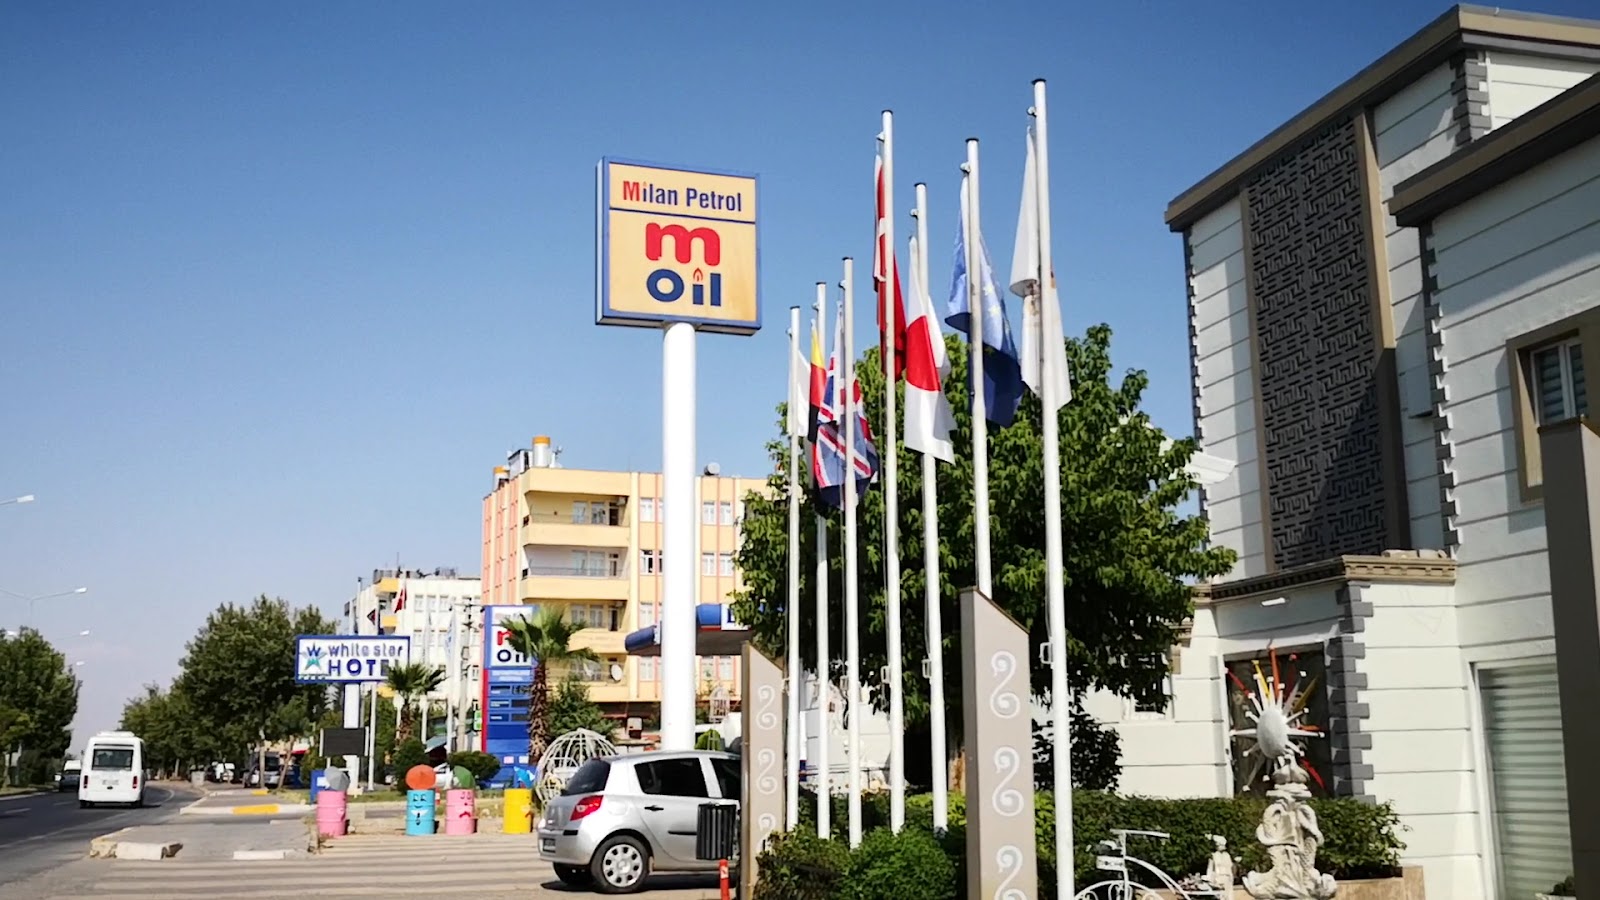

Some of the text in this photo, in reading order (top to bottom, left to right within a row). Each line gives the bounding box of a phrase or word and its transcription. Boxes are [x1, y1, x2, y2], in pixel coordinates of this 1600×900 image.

[623, 180, 742, 212] Milan Petrol
[328, 643, 403, 657] white star
